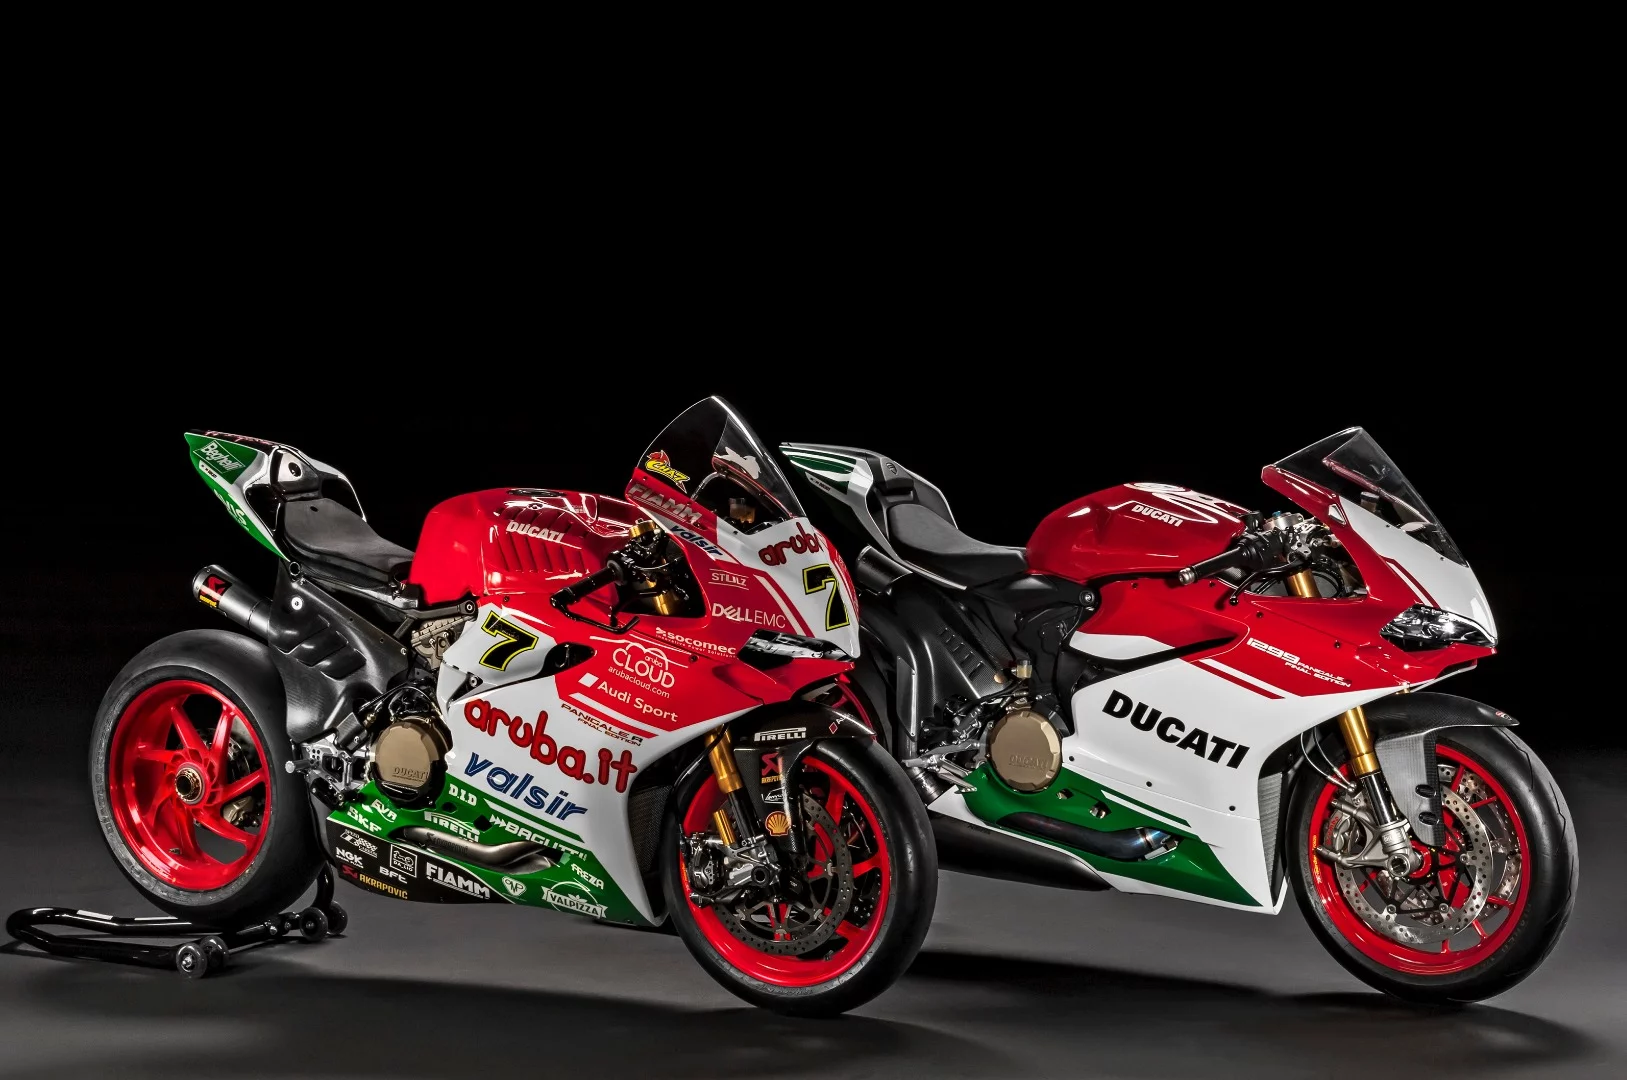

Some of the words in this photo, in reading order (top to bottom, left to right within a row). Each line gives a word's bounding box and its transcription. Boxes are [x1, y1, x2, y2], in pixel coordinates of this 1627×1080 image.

[628, 483, 702, 524] FIAMM
[1131, 504, 1184, 527] DUCATI
[506, 520, 565, 543] DUCATI
[758, 522, 824, 566] arub
[802, 563, 850, 632] 7
[479, 609, 539, 672] 7
[667, 631, 737, 655] socomec
[1246, 637, 1300, 665] 1299
[608, 666, 670, 699] arubacloud.com
[612, 647, 675, 688] CLOUD
[598, 681, 632, 704] Audi
[633, 697, 678, 722] Sport
[464, 698, 638, 793] aruba.it
[753, 727, 807, 742] PIRELLI
[1102, 689, 1250, 769] DUCATI
[463, 752, 588, 821] valsir
[346, 806, 382, 833] SKF
[424, 811, 480, 843] PIRELLI
[335, 846, 363, 866] NGK
[426, 861, 490, 899] FIAMM
[549, 893, 599, 916] VALPIZZA
